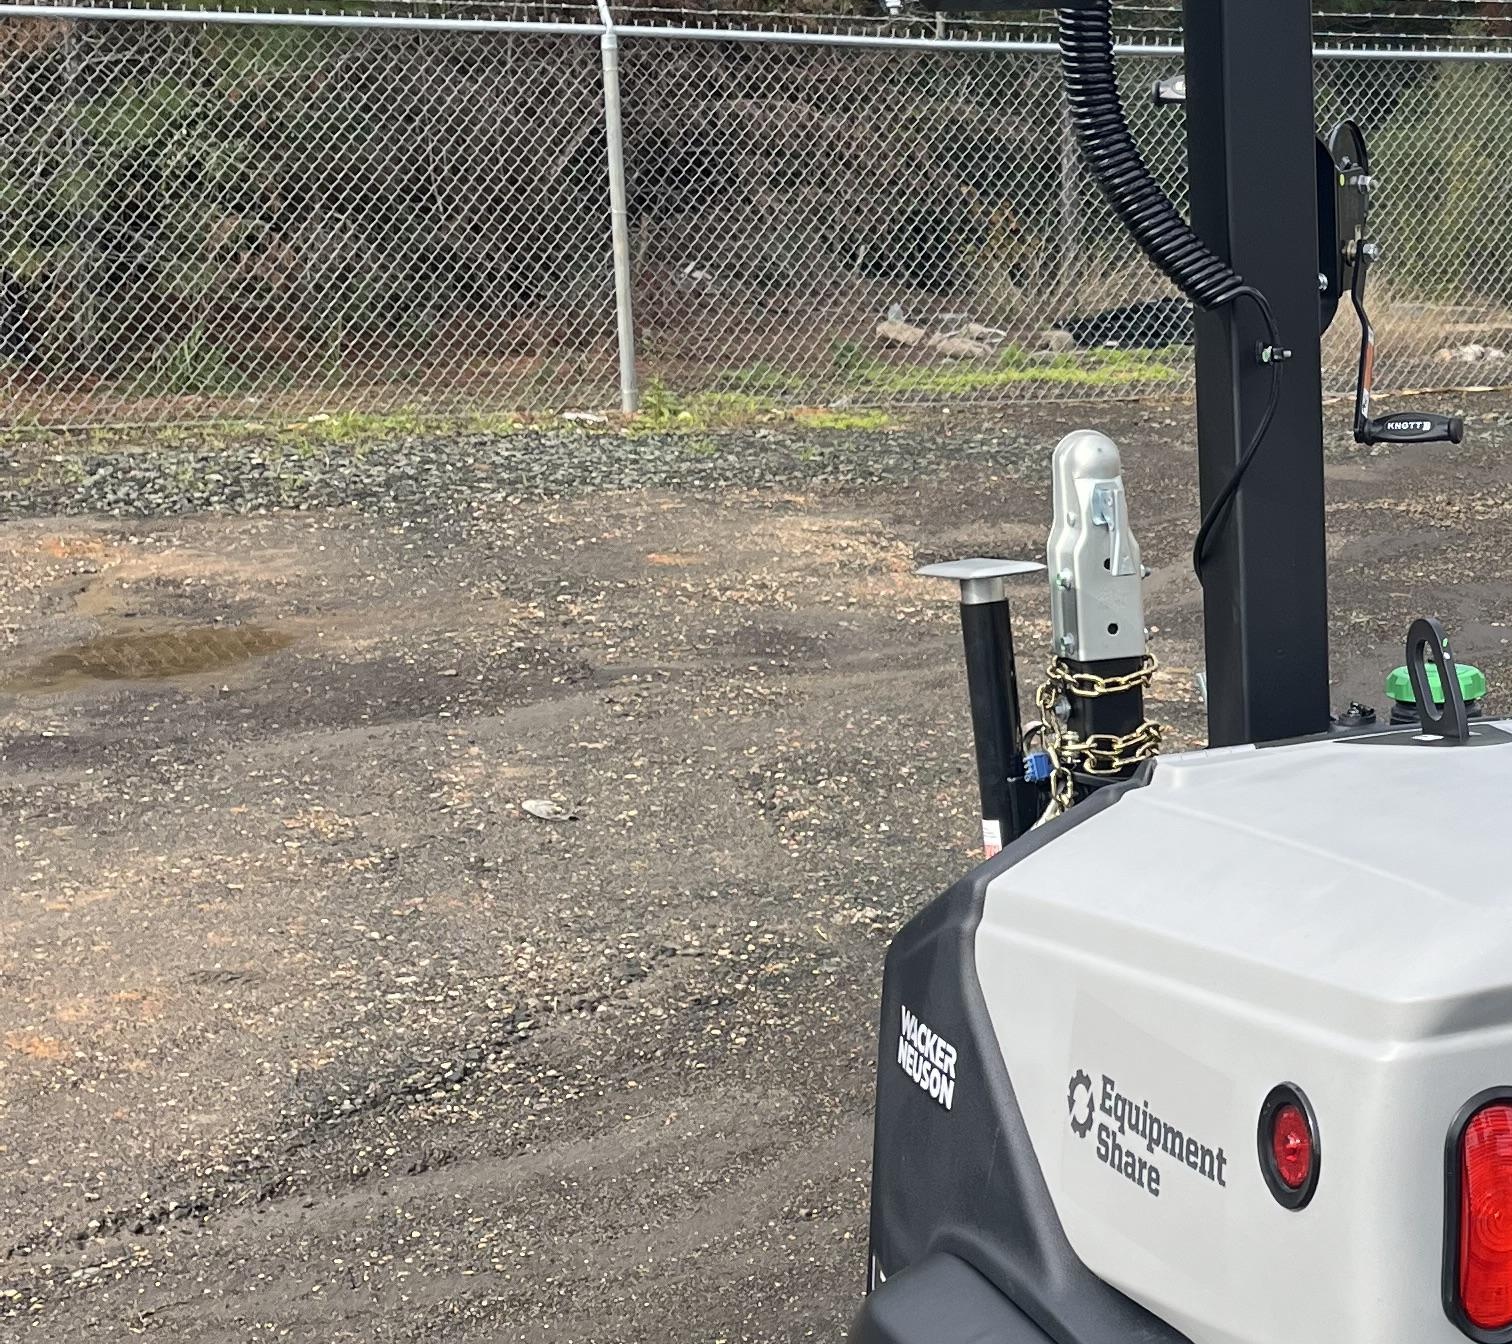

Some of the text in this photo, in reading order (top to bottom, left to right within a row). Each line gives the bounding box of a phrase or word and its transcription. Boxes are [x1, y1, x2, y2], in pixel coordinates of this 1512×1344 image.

[1387, 421, 1422, 430] KNOTT
[898, 1036, 955, 1110] NEUSON
[902, 1005, 957, 1078] WACKER
[1097, 1123, 1161, 1197] Share
[1100, 1074, 1227, 1187] Equipment
